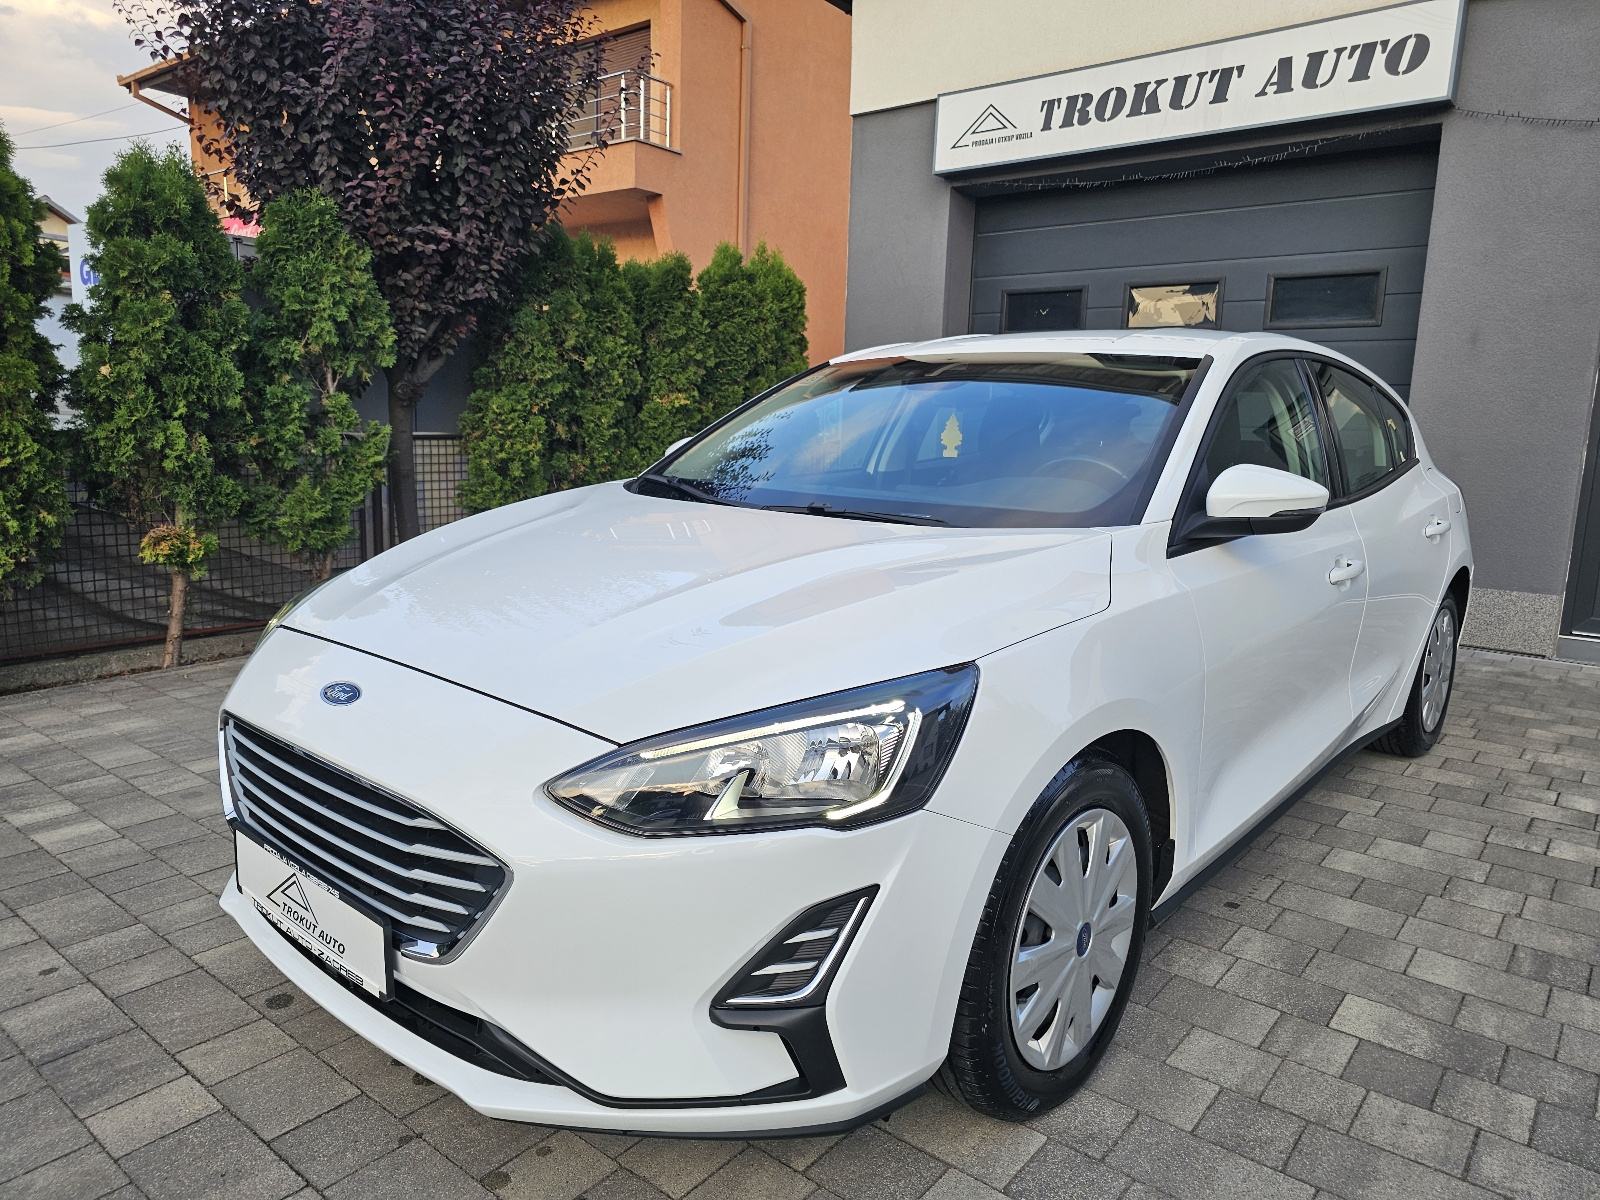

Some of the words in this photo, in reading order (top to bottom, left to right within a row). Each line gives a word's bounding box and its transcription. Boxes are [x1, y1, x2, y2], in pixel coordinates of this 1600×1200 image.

[1040, 64, 1244, 132] TROKUT
[1254, 33, 1431, 98] AUTO
[971, 137, 994, 148] PRODAJA
[998, 134, 1015, 143] OTKUP
[1015, 131, 1033, 141] VOZILA
[281, 901, 318, 934] TROKUT
[318, 930, 345, 955] AUTO
